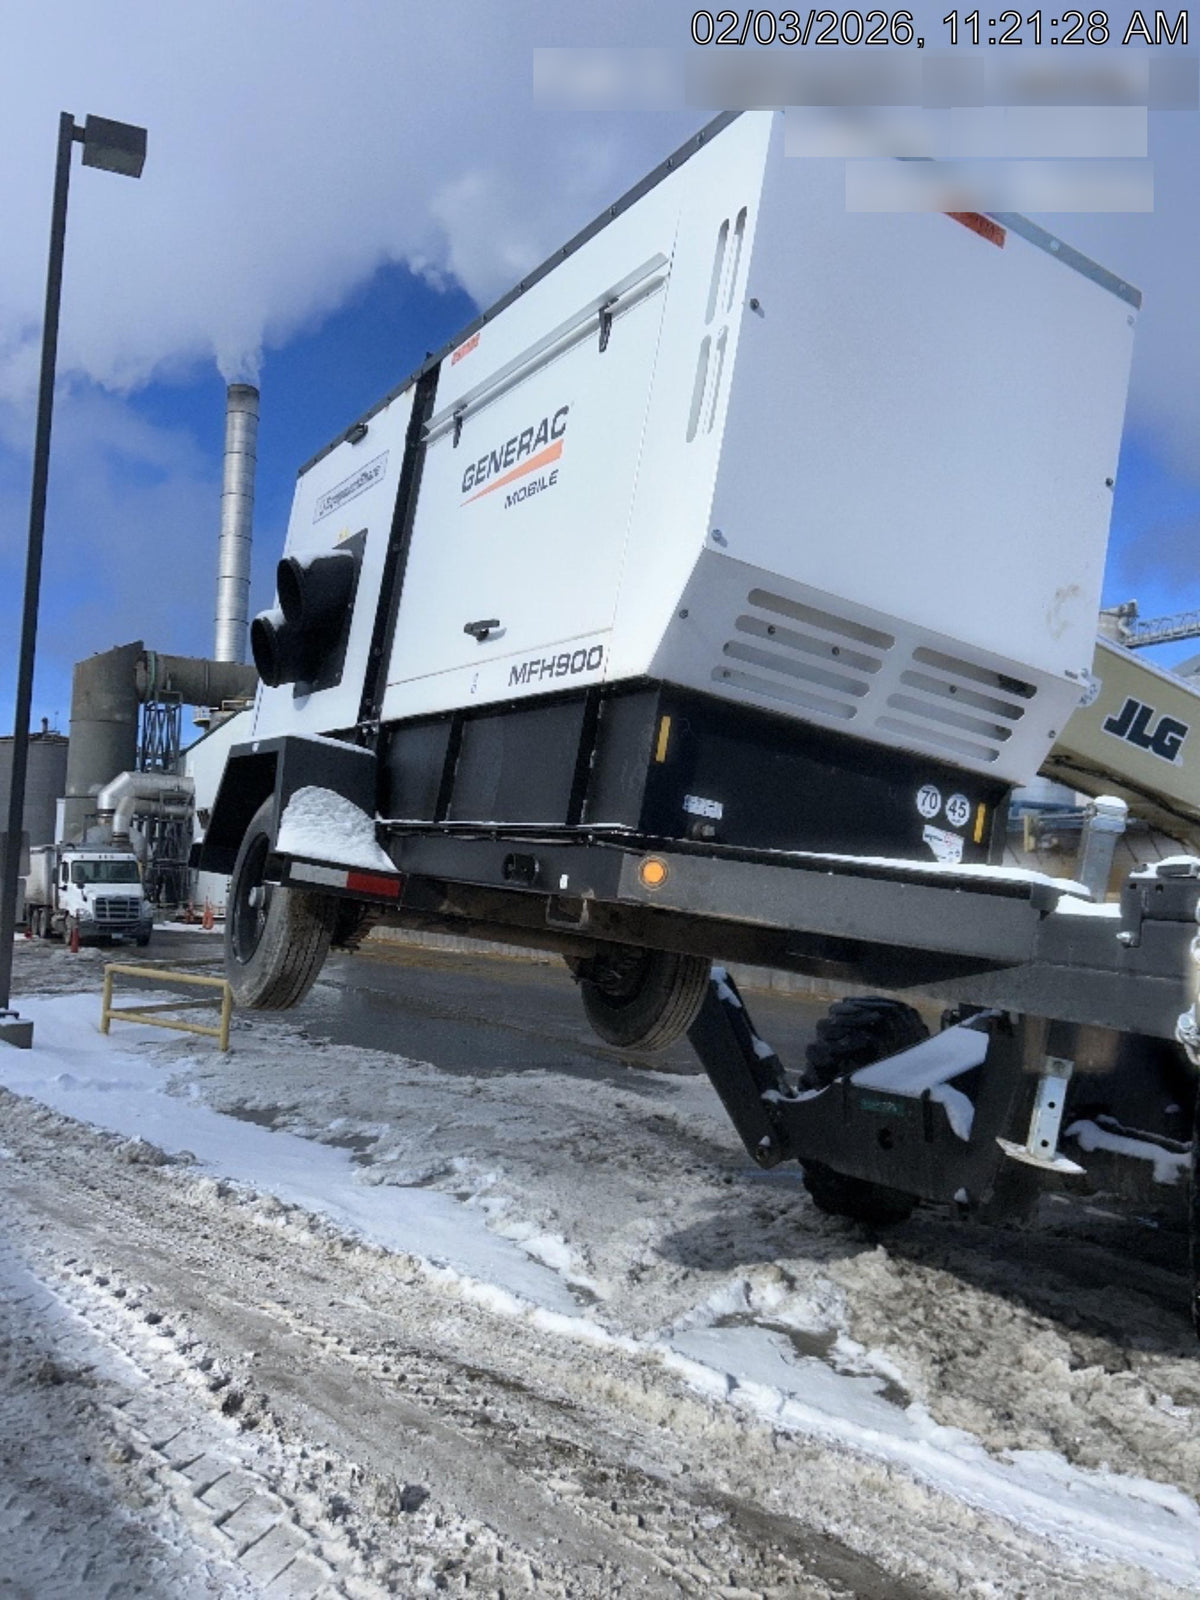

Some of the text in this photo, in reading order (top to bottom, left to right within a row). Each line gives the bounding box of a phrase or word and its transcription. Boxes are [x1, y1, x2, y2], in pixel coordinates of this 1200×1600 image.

[462, 405, 569, 493] GENERAC
[504, 468, 559, 509] MOBILE
[508, 644, 603, 687] MFH900
[1102, 697, 1189, 763] JLG
[921, 789, 938, 810] 70
[948, 799, 966, 818] 45
